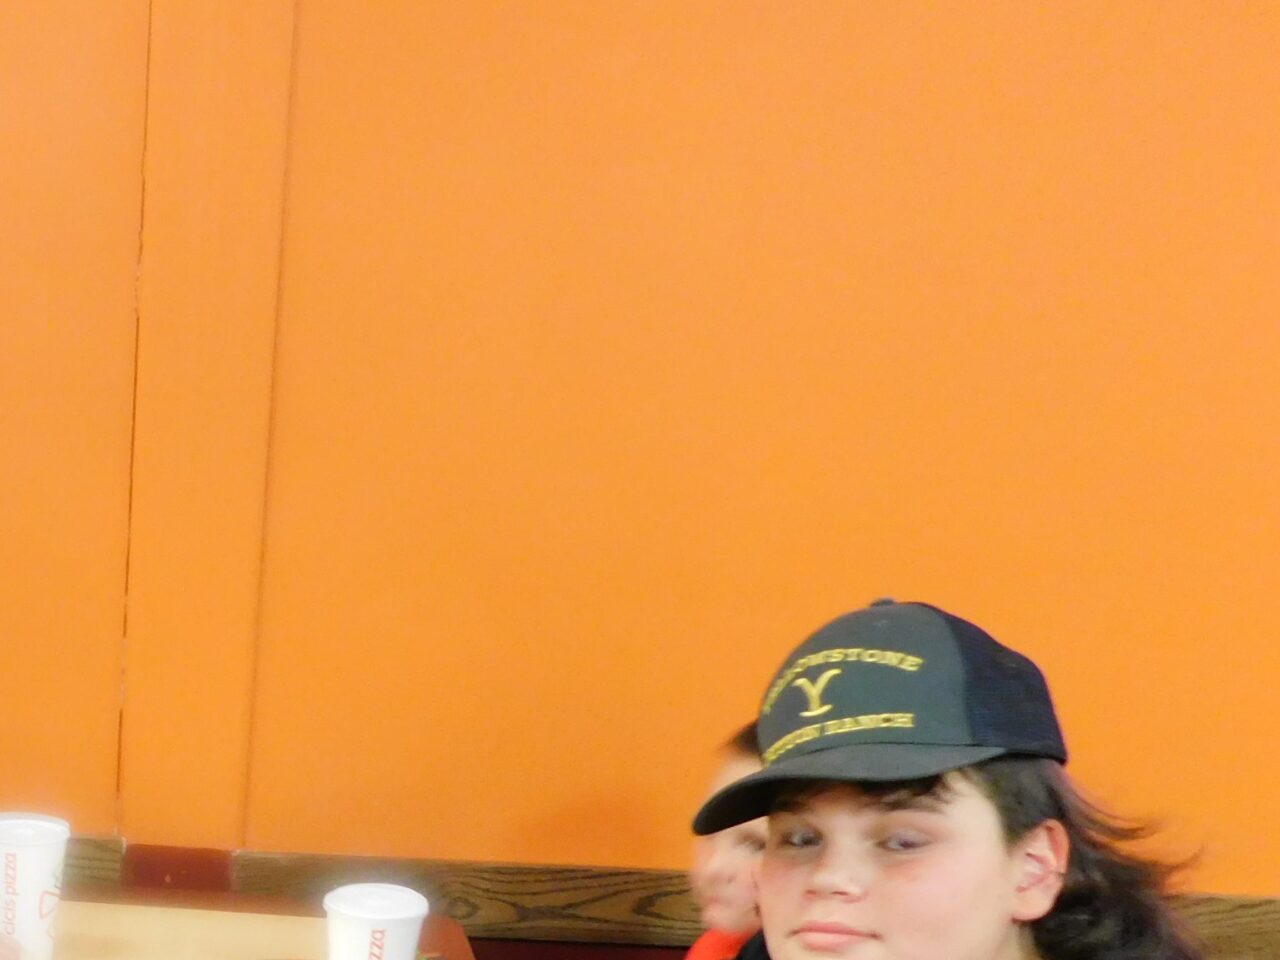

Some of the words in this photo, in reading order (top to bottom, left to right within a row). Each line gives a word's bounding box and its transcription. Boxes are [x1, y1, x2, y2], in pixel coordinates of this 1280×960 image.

[792, 668, 841, 717] Y
[824, 713, 915, 735] RANCH
[3, 852, 20, 896] pizza
